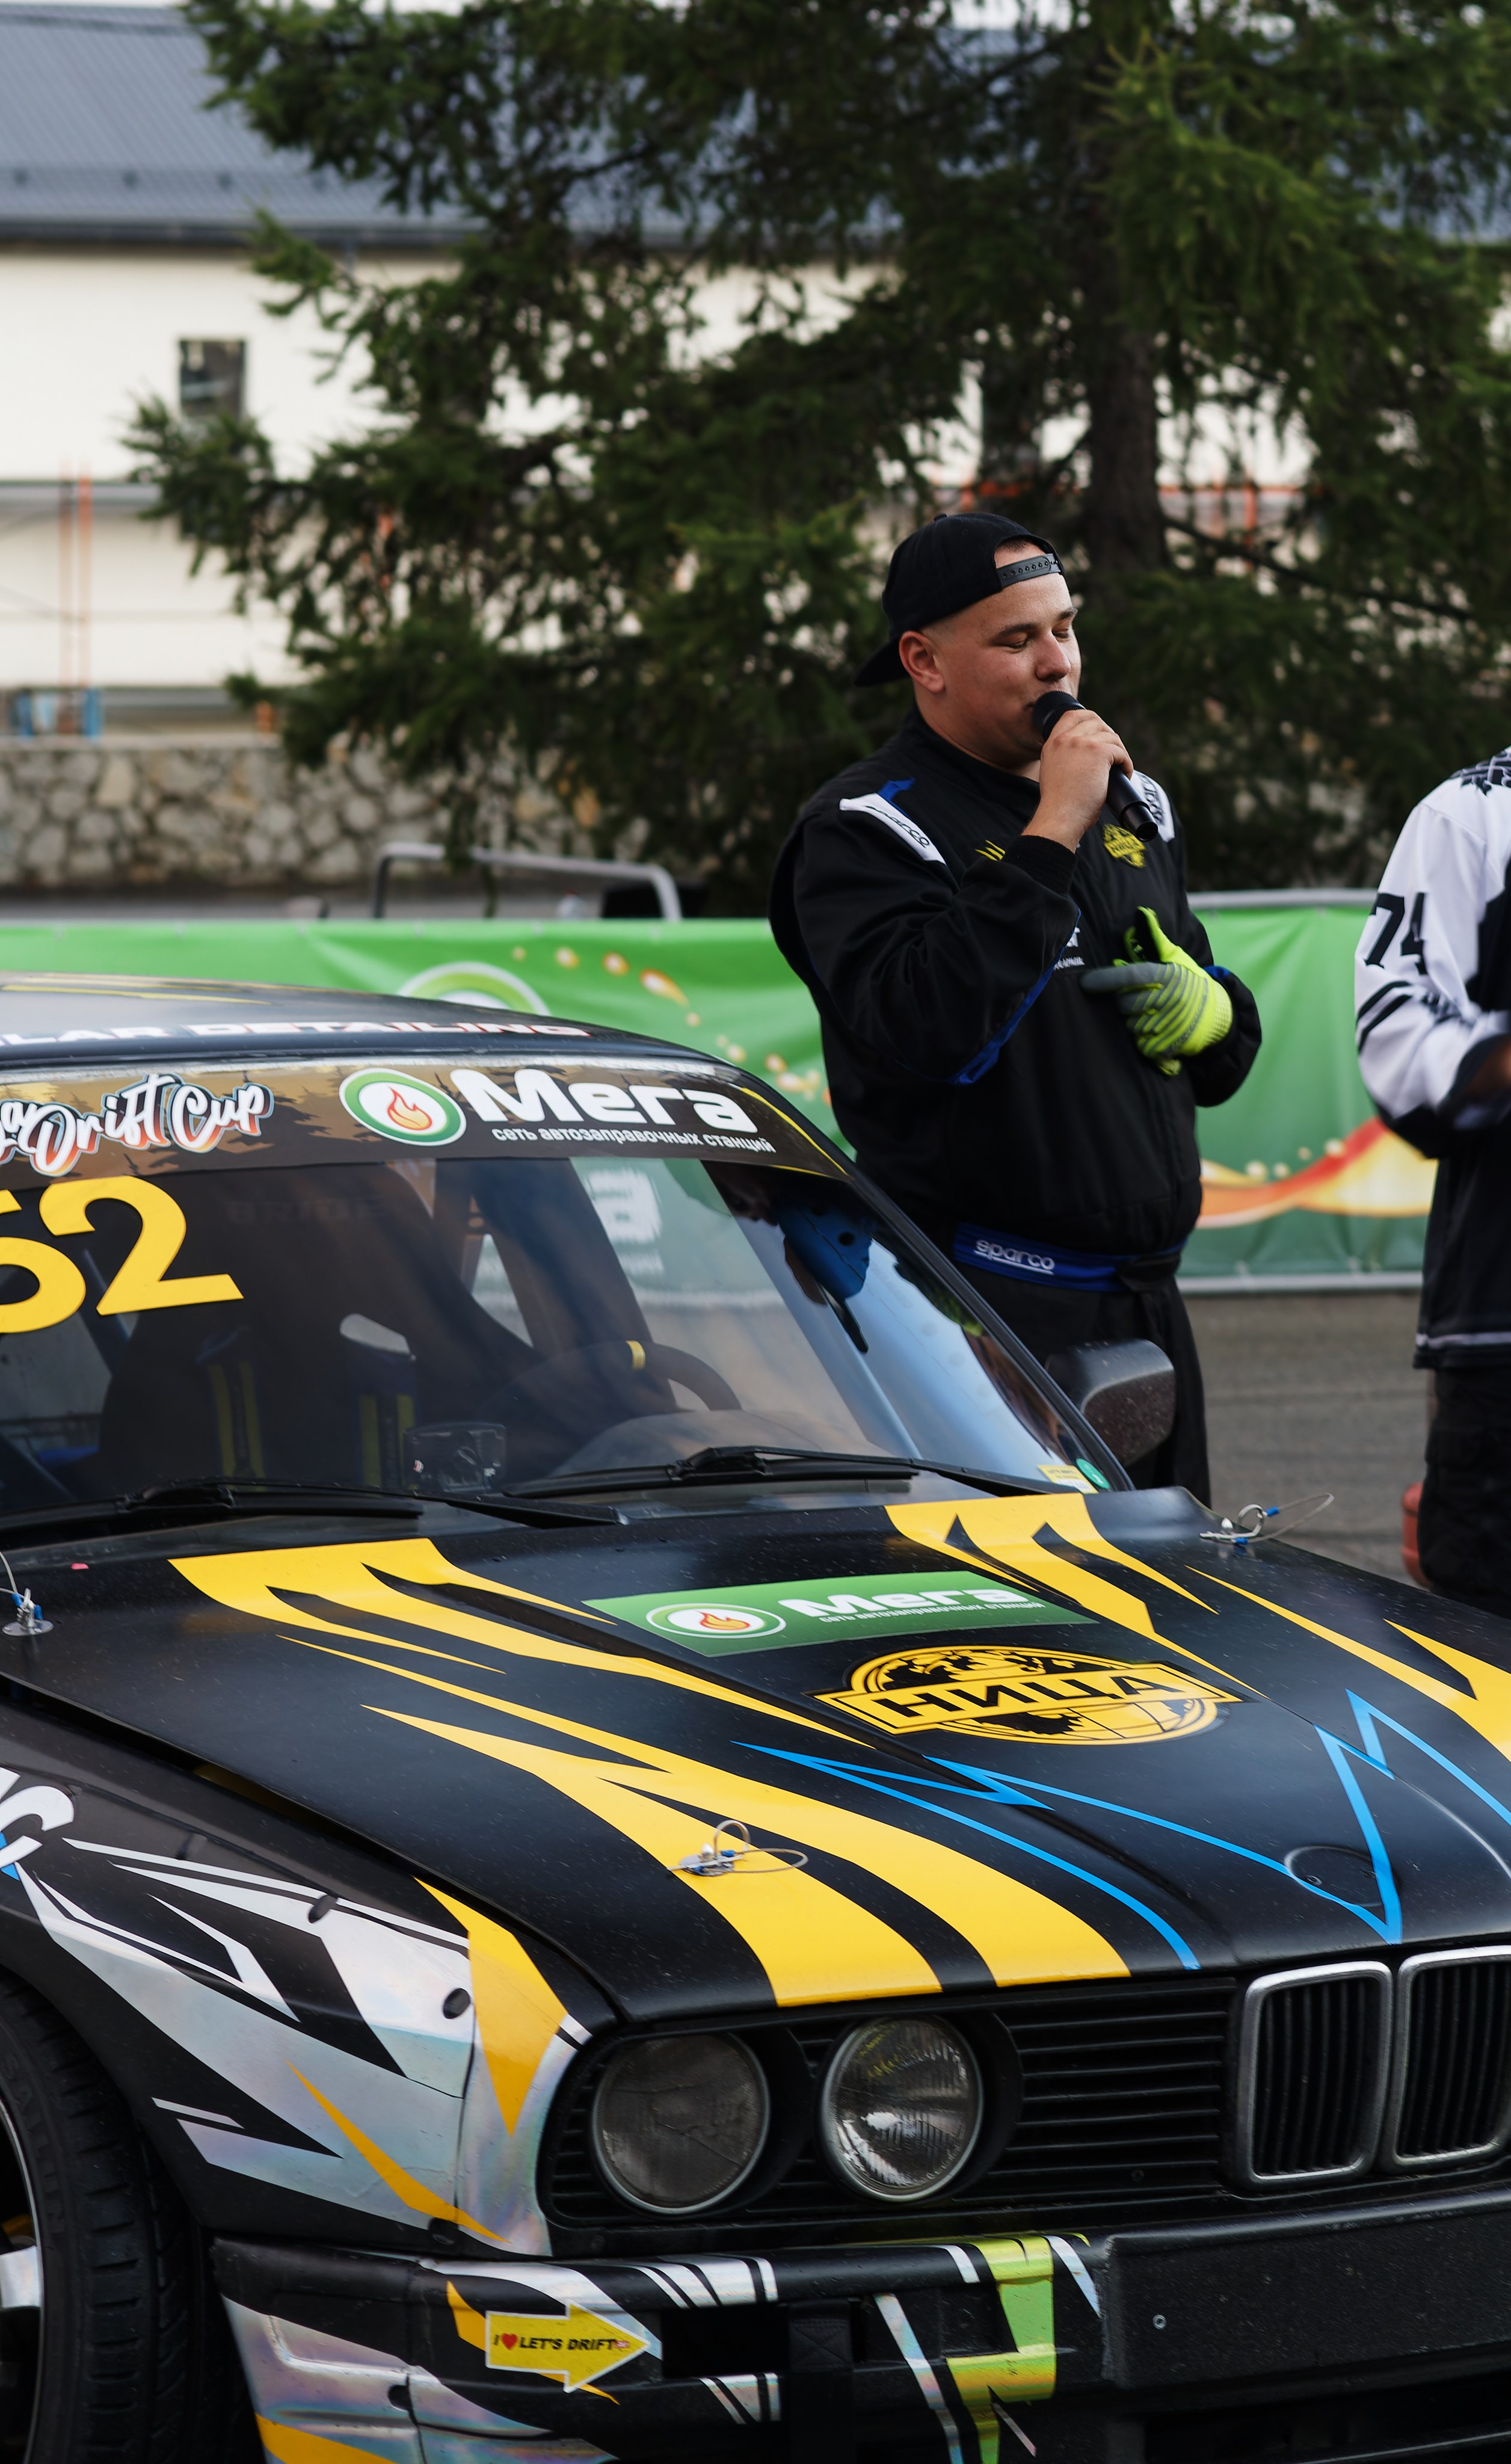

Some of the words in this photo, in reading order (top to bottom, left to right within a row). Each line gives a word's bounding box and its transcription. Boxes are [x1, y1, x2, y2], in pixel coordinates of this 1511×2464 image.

[0, 1026, 170, 1046] LAR
[185, 1021, 592, 1037] DETAILING
[450, 1069, 758, 1133] Мега
[168, 1083, 274, 1153] Cup
[491, 1127, 539, 1142] сеть
[539, 1128, 704, 1145] автозаправочных
[701, 1133, 777, 1153] станций
[975, 1240, 1055, 1272] sparco
[778, 1589, 1029, 1616] Мега
[871, 1676, 1183, 1717] НИЦА
[519, 2337, 564, 2350] LET'S
